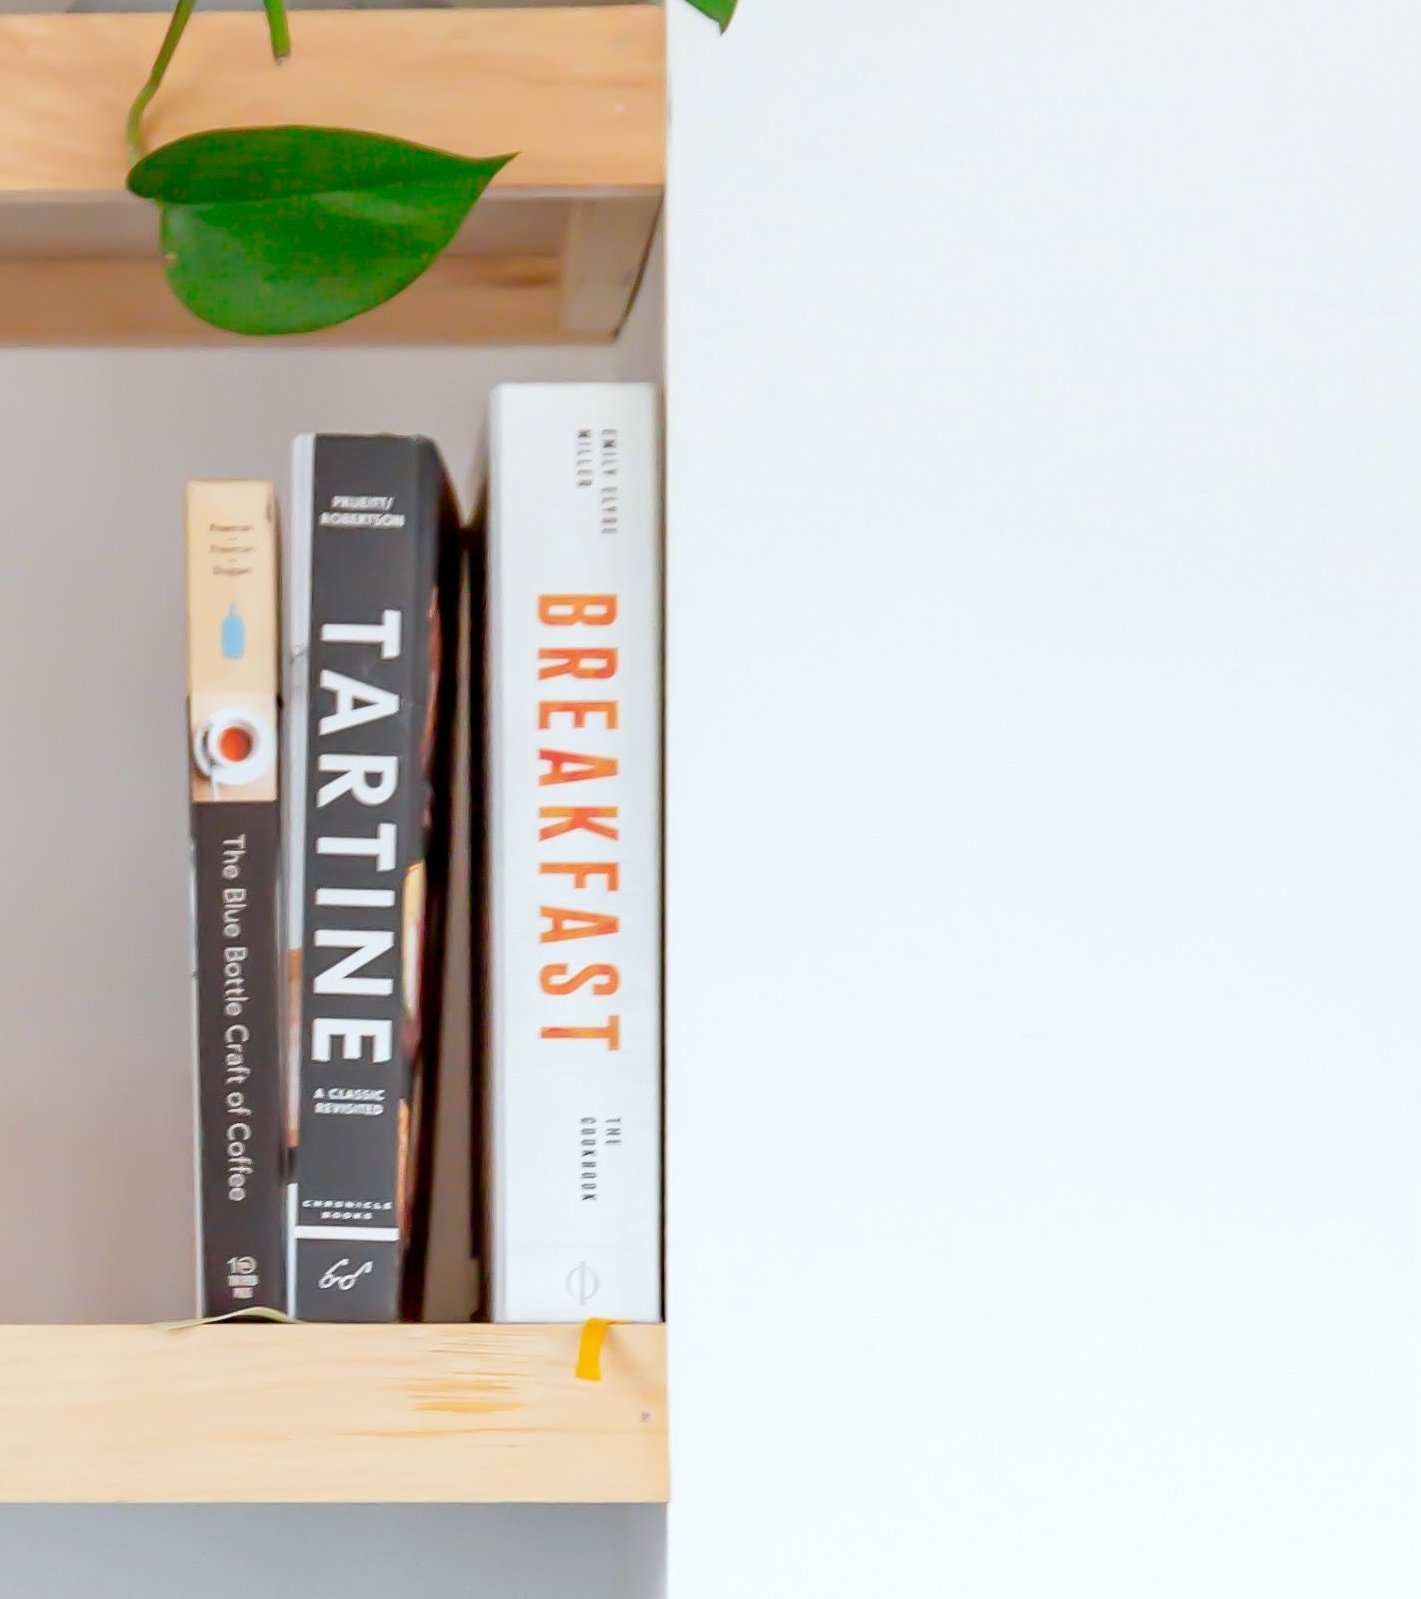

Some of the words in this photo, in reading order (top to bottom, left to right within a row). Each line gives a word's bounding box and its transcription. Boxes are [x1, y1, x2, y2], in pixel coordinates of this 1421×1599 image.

[311, 609, 402, 1063] TARTINE
[537, 592, 620, 1052] BREAKFAST
[222, 833, 247, 880] The
[222, 888, 247, 938] Blue
[223, 947, 250, 1017] Bottle
[225, 1024, 251, 1085] Craft
[226, 1091, 254, 1116] of
[327, 1088, 386, 1102] CLASSIC
[227, 1122, 254, 1202] Coffee
[580, 1116, 597, 1202] COOKBOOK
[301, 1199, 393, 1210] CHRONICLE
